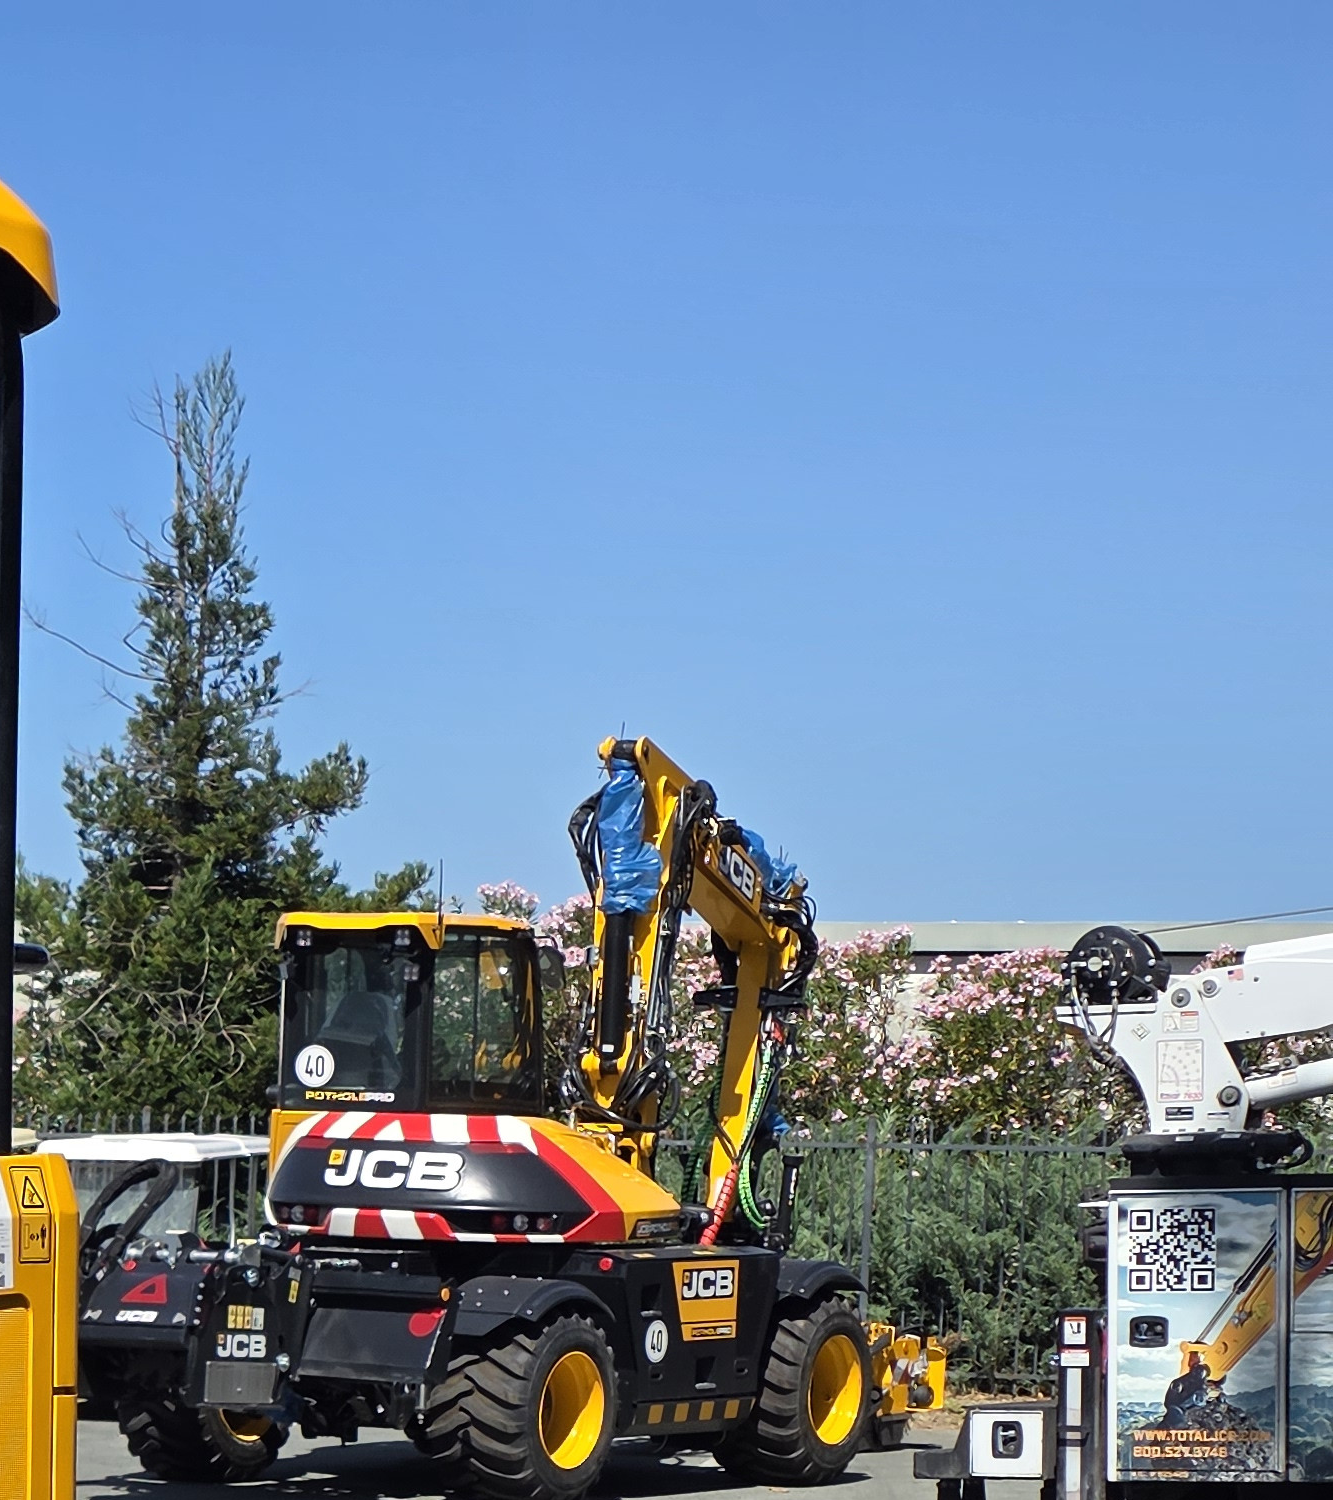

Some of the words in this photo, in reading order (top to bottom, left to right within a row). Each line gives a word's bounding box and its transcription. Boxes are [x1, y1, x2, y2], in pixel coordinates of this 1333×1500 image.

[719, 846, 755, 900] JCB
[304, 1055, 325, 1078] 40
[324, 1149, 465, 1191] JCB
[683, 1269, 733, 1298] JCB
[115, 1309, 159, 1323] JCB
[217, 1334, 267, 1358] JCB
[650, 1329, 663, 1353] 40
